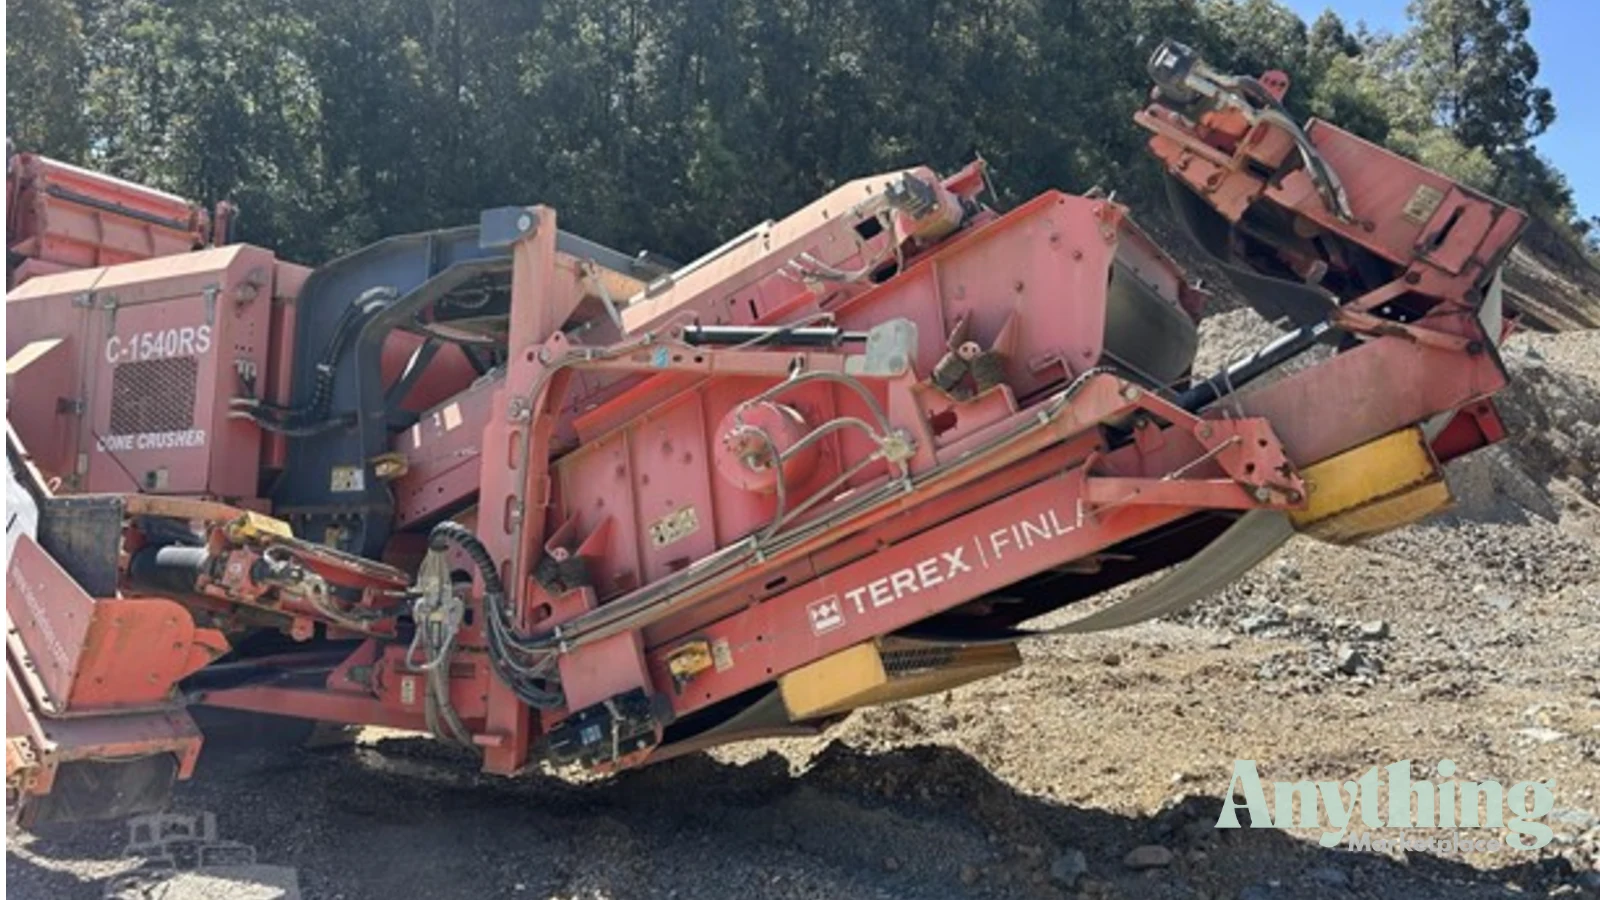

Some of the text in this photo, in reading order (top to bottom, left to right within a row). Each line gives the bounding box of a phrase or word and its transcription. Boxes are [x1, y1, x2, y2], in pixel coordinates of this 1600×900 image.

[105, 325, 211, 363] C-1540RS
[97, 429, 205, 452] CONE CRUSHER
[845, 546, 971, 614] TEREX
